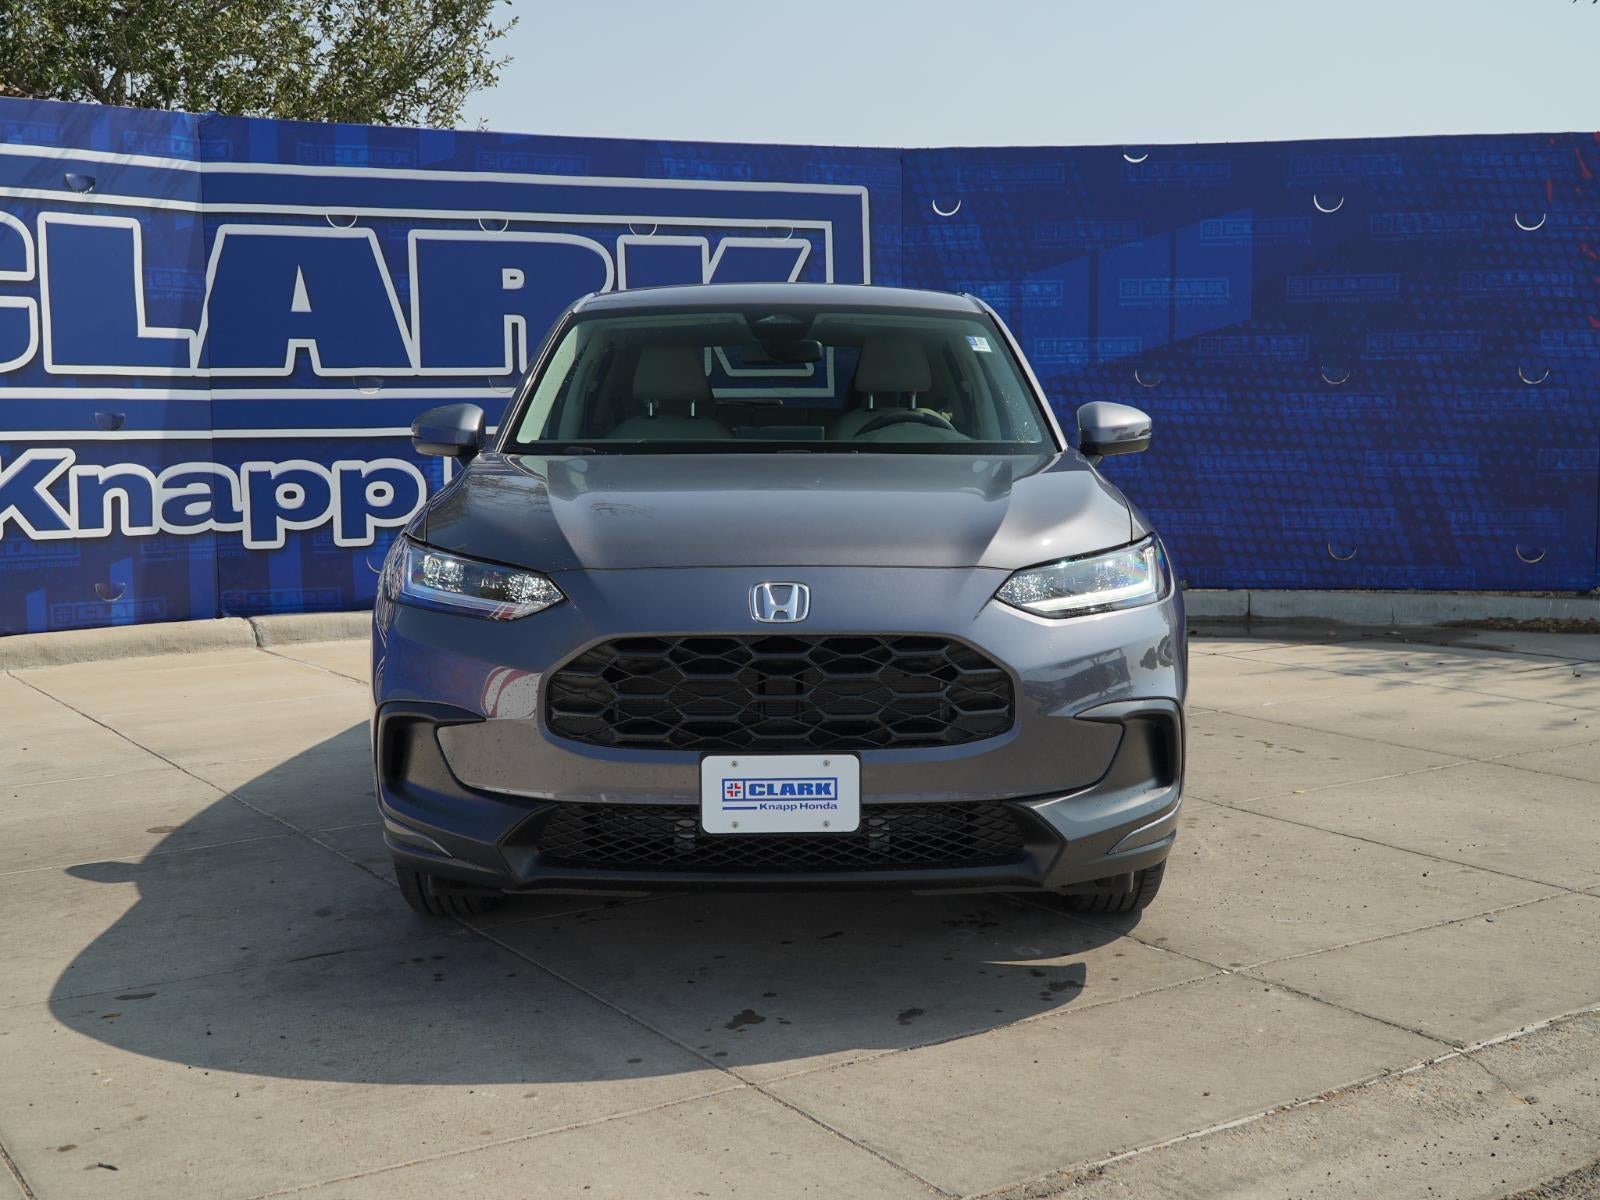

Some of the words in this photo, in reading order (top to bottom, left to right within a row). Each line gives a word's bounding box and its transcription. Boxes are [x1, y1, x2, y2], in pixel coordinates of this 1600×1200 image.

[0, 211, 812, 378] LAR
[0, 448, 427, 549] Knapp
[749, 782, 831, 796] CLARK
[759, 803, 797, 811] Knapp
[799, 802, 838, 810] Honda
